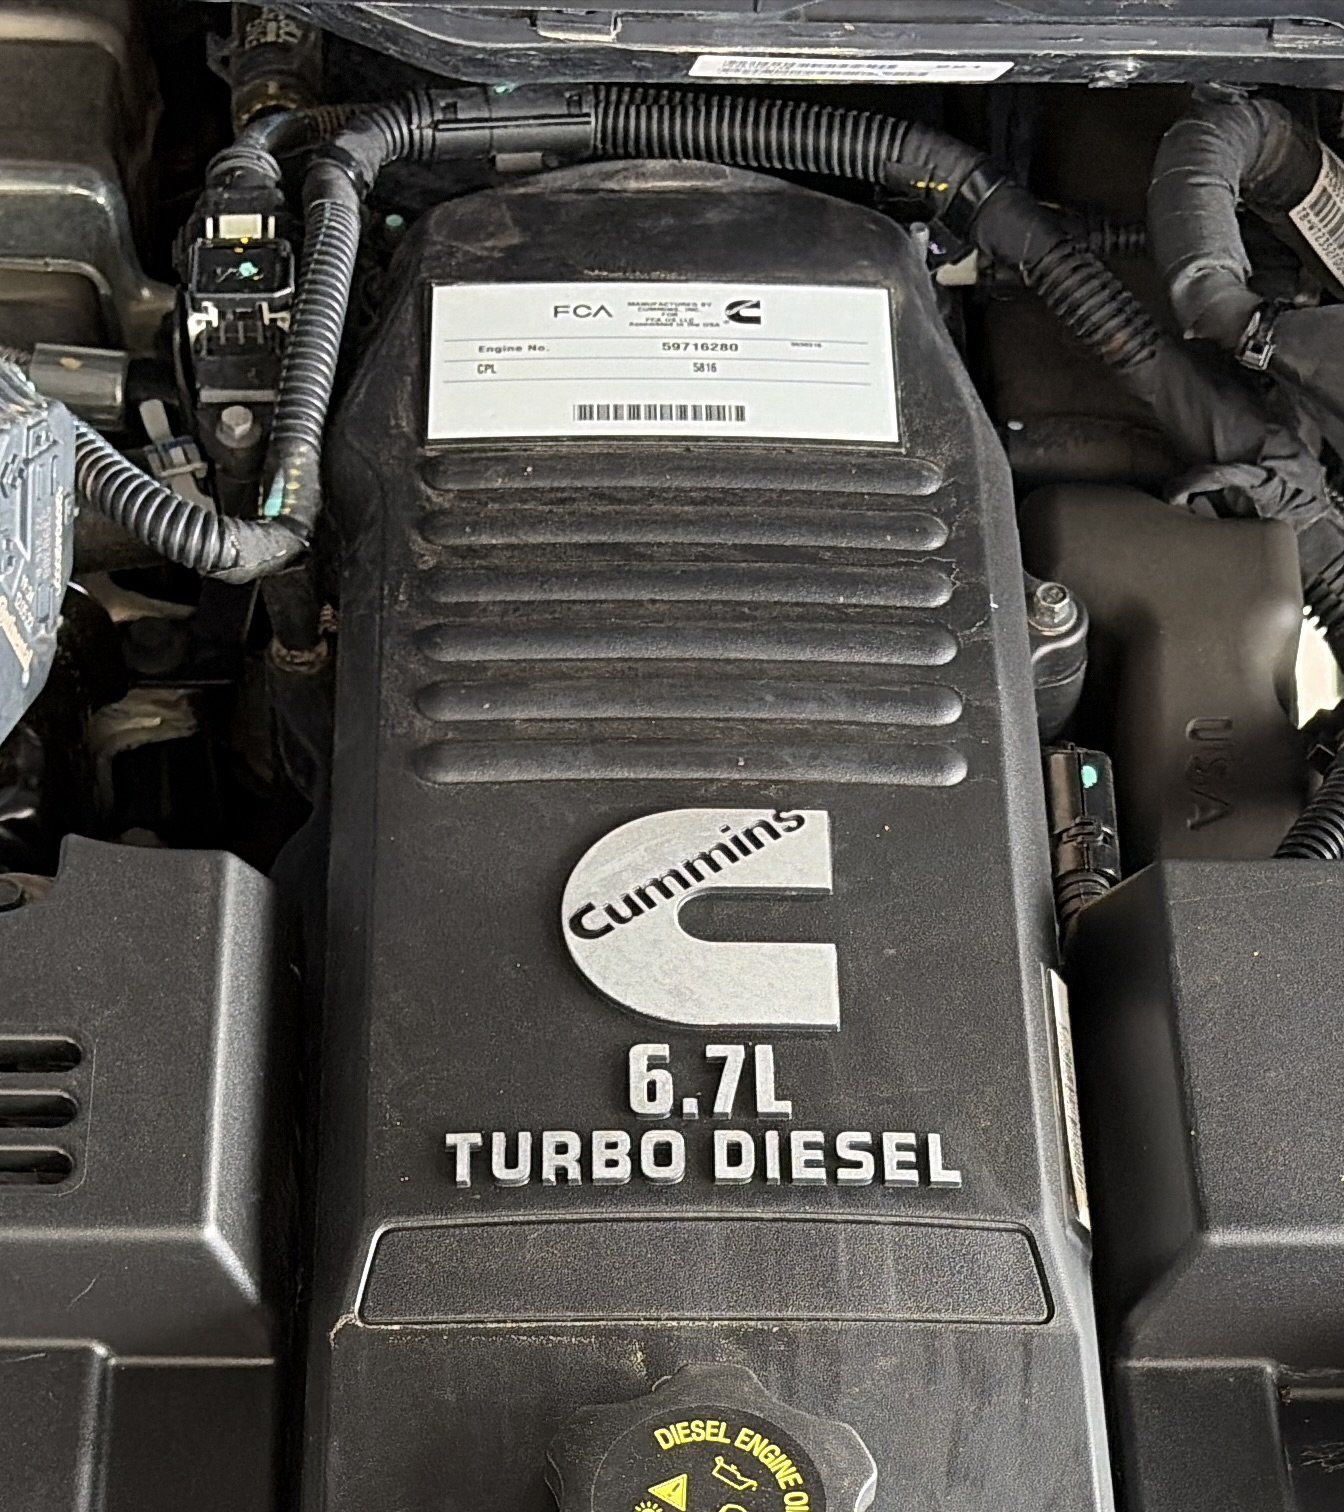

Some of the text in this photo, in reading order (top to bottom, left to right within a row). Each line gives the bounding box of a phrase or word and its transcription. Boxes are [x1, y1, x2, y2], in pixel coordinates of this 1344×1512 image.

[553, 303, 613, 319] FCA
[476, 362, 498, 375] CPL
[477, 343, 523, 355] Engine
[568, 807, 806, 941] Cummins
[627, 1041, 793, 1121] 6.7L
[444, 1128, 964, 1188] TURBO DIESEL
[653, 1418, 732, 1451] DIESEL
[733, 1426, 805, 1491] ENGINE
